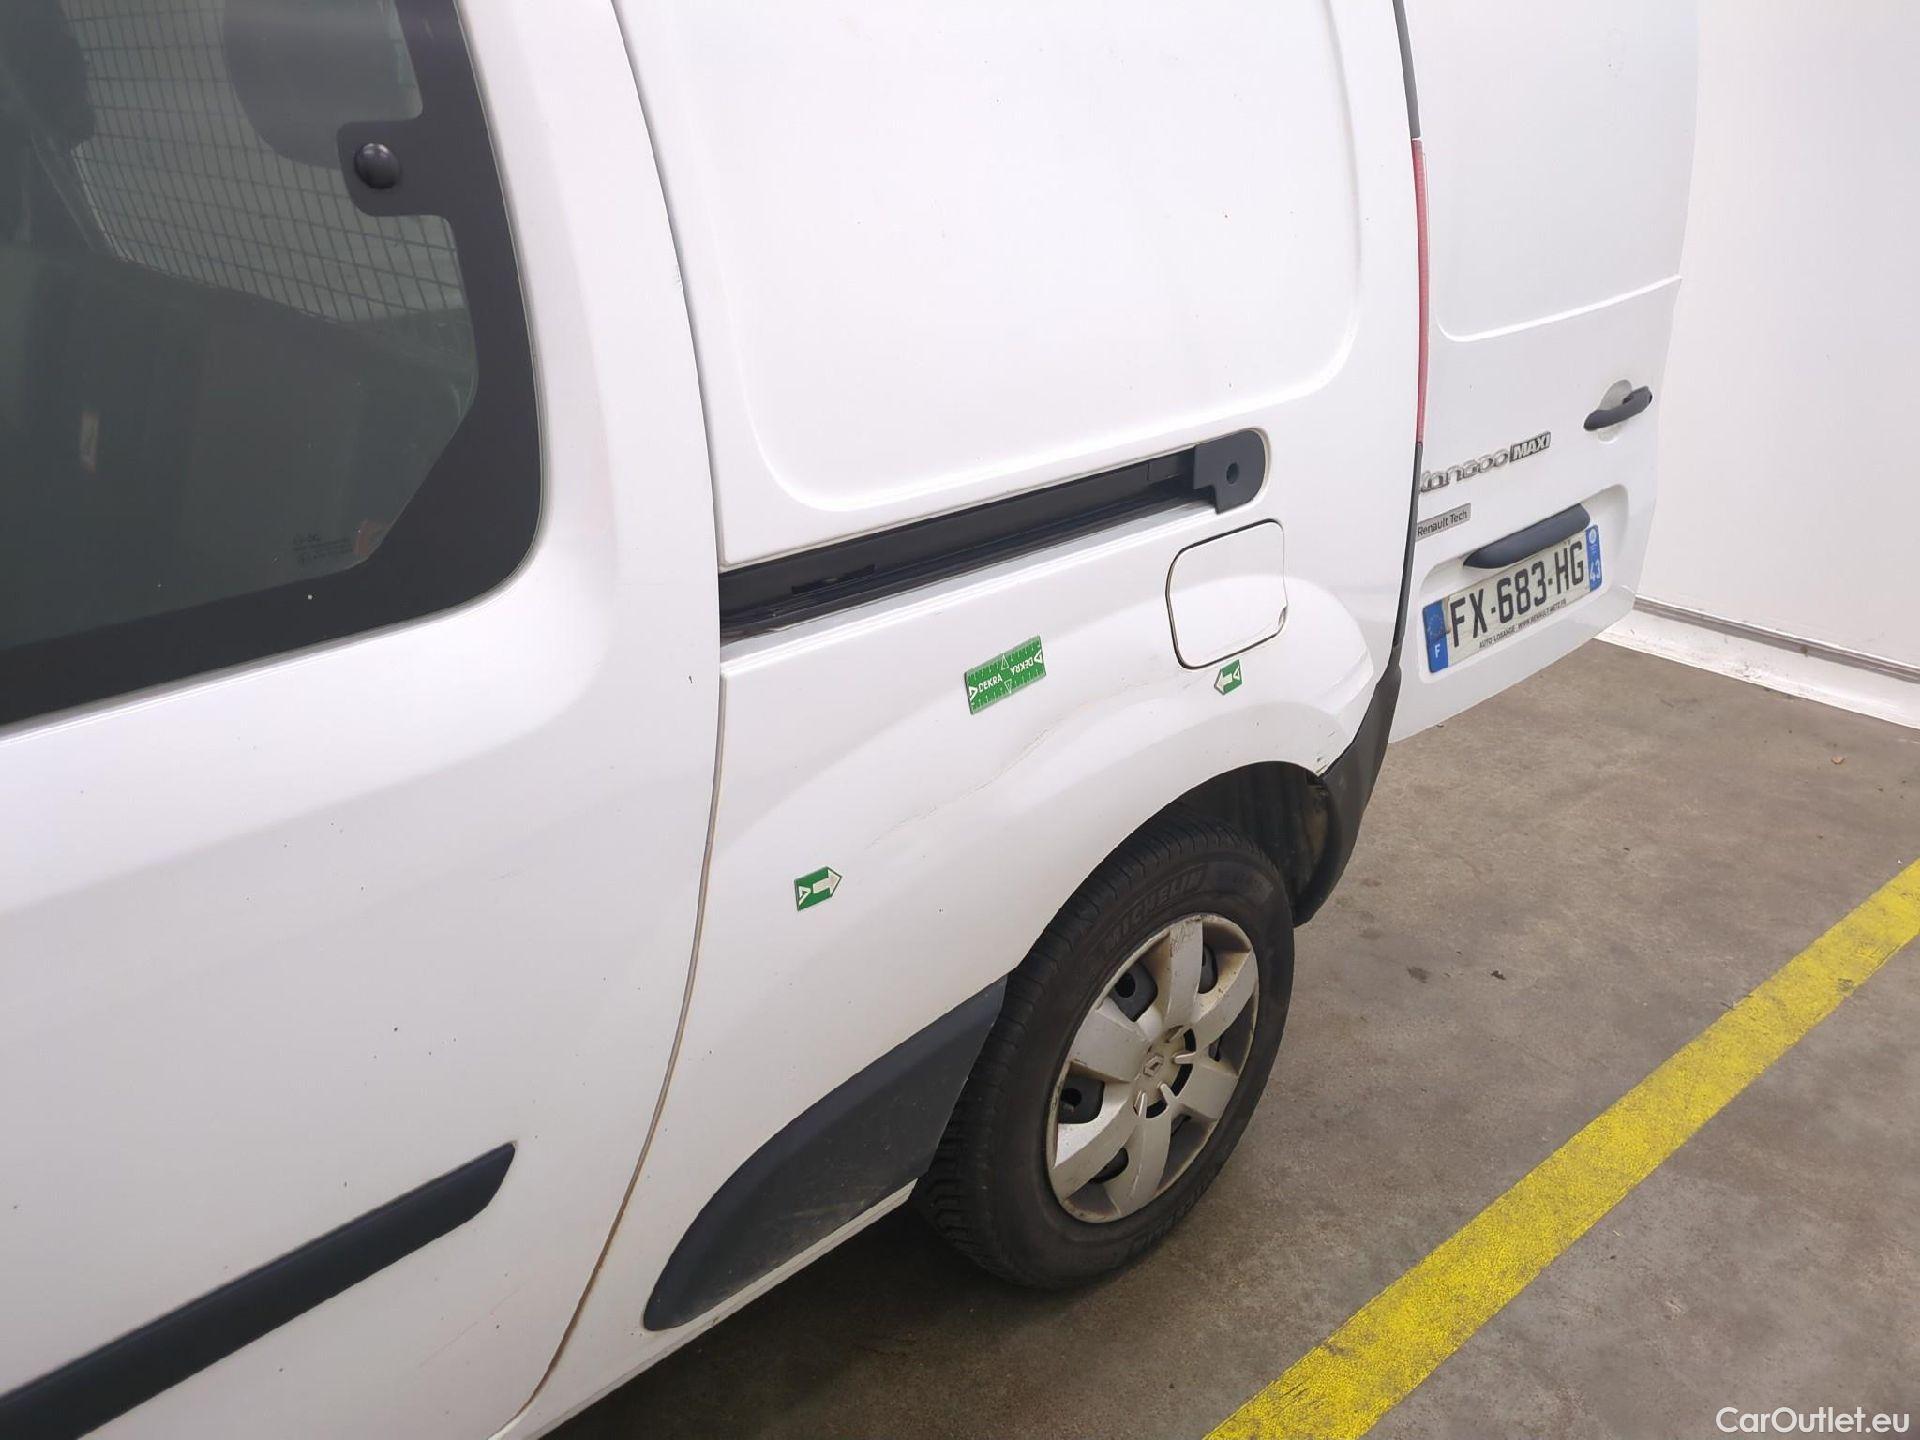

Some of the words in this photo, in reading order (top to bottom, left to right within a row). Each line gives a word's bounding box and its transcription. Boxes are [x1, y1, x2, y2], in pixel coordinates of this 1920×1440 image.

[1513, 434, 1550, 460] MAXI
[1417, 517, 1448, 536] Renault
[1450, 509, 1467, 524] Tech
[1434, 643, 1441, 659] F
[1010, 657, 1034, 675] DEKRA
[978, 673, 1002, 693] DEKRA
